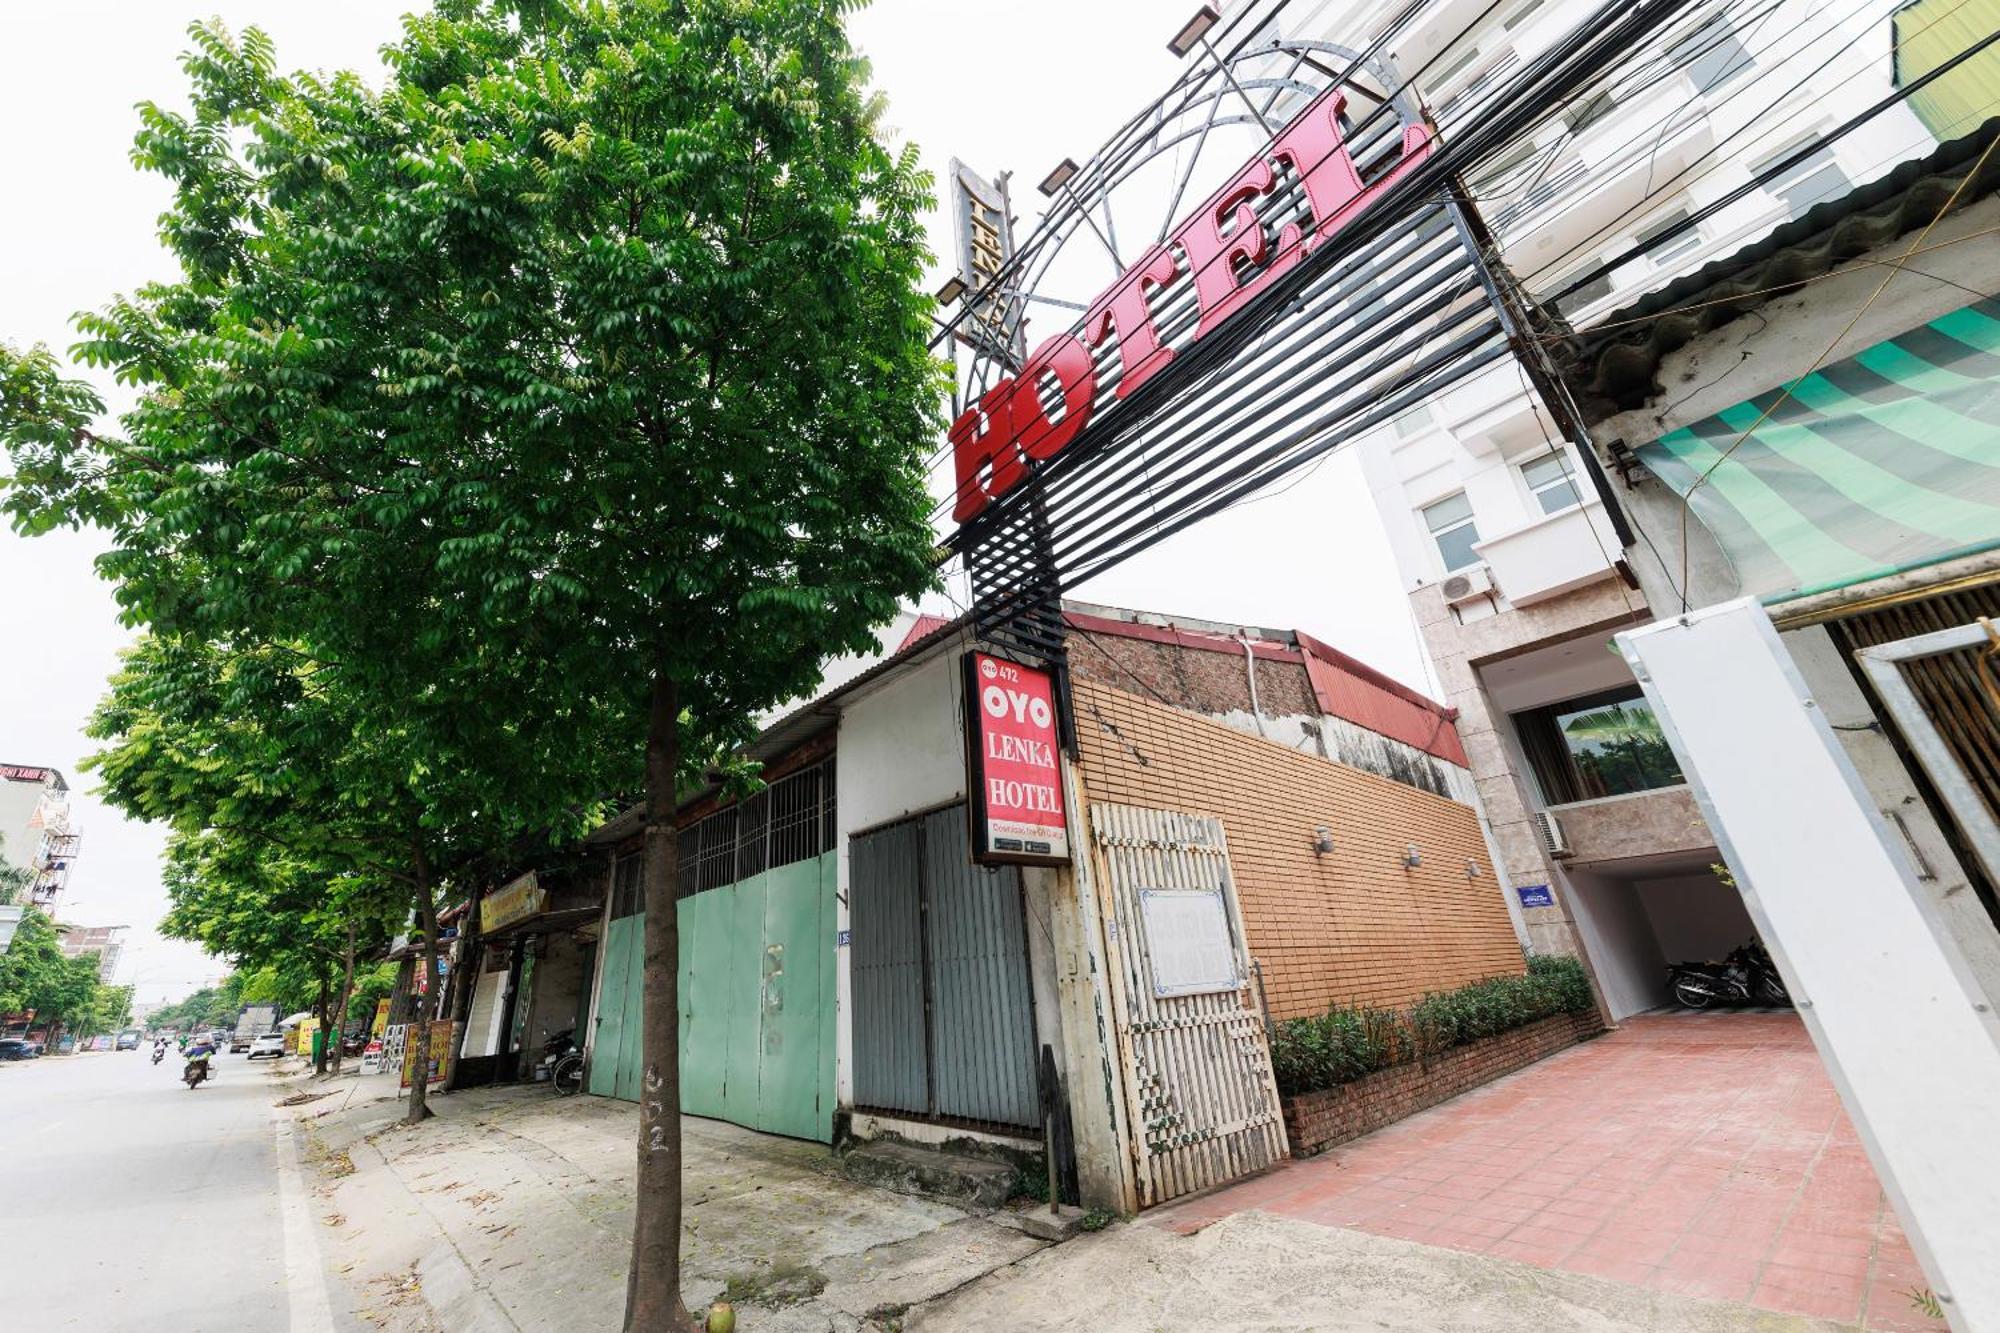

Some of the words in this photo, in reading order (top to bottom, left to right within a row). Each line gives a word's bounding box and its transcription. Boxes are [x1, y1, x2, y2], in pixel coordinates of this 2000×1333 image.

[948, 88, 1434, 524] HOTEL
[999, 666, 1019, 683] 472
[983, 685, 1051, 729] OYO
[987, 732, 1056, 769] LENKA
[988, 778, 1062, 814] HOTEL
